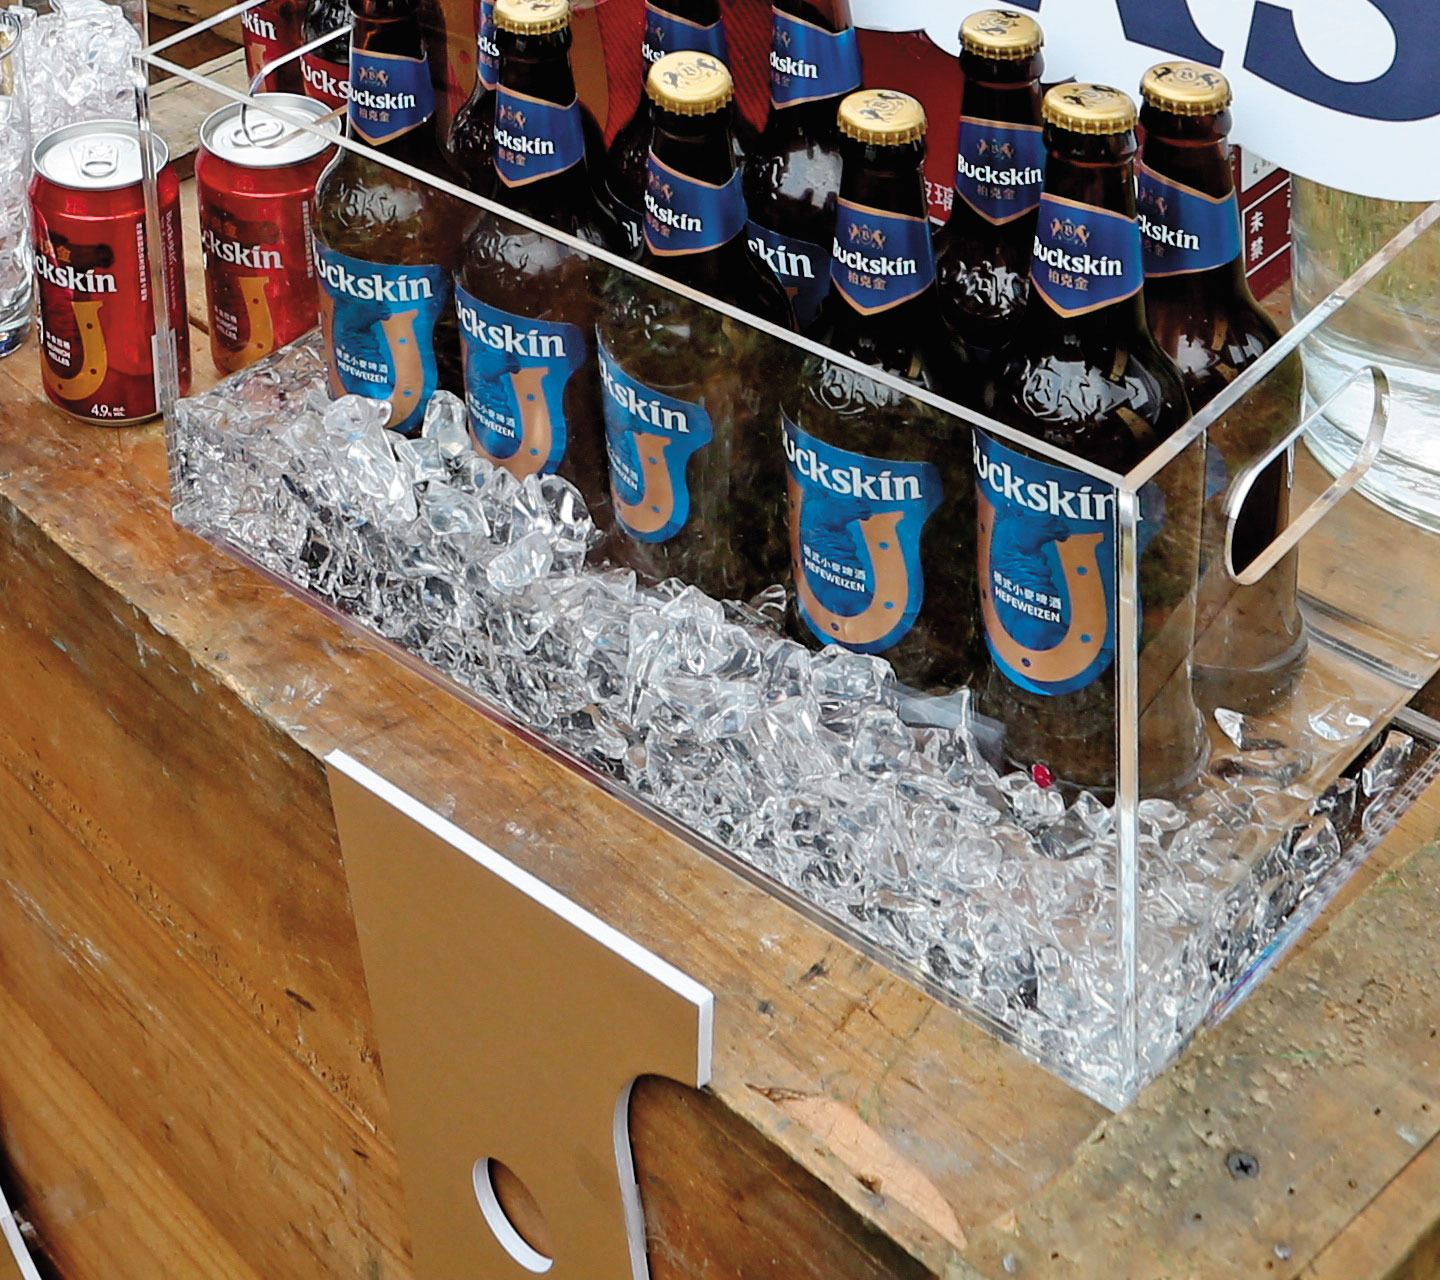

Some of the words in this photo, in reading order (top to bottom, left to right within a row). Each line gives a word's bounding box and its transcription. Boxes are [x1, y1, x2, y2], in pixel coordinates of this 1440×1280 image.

[350, 85, 417, 110] uckskin
[957, 152, 1043, 186] Buckskin
[36, 254, 118, 293] ckskin
[314, 254, 434, 303] uckskin
[782, 426, 923, 502] uckskin
[973, 443, 1144, 522] uckskin
[804, 557, 866, 593] HEFEWEIZEN
[994, 585, 1061, 624] HEFEWEIZEN
